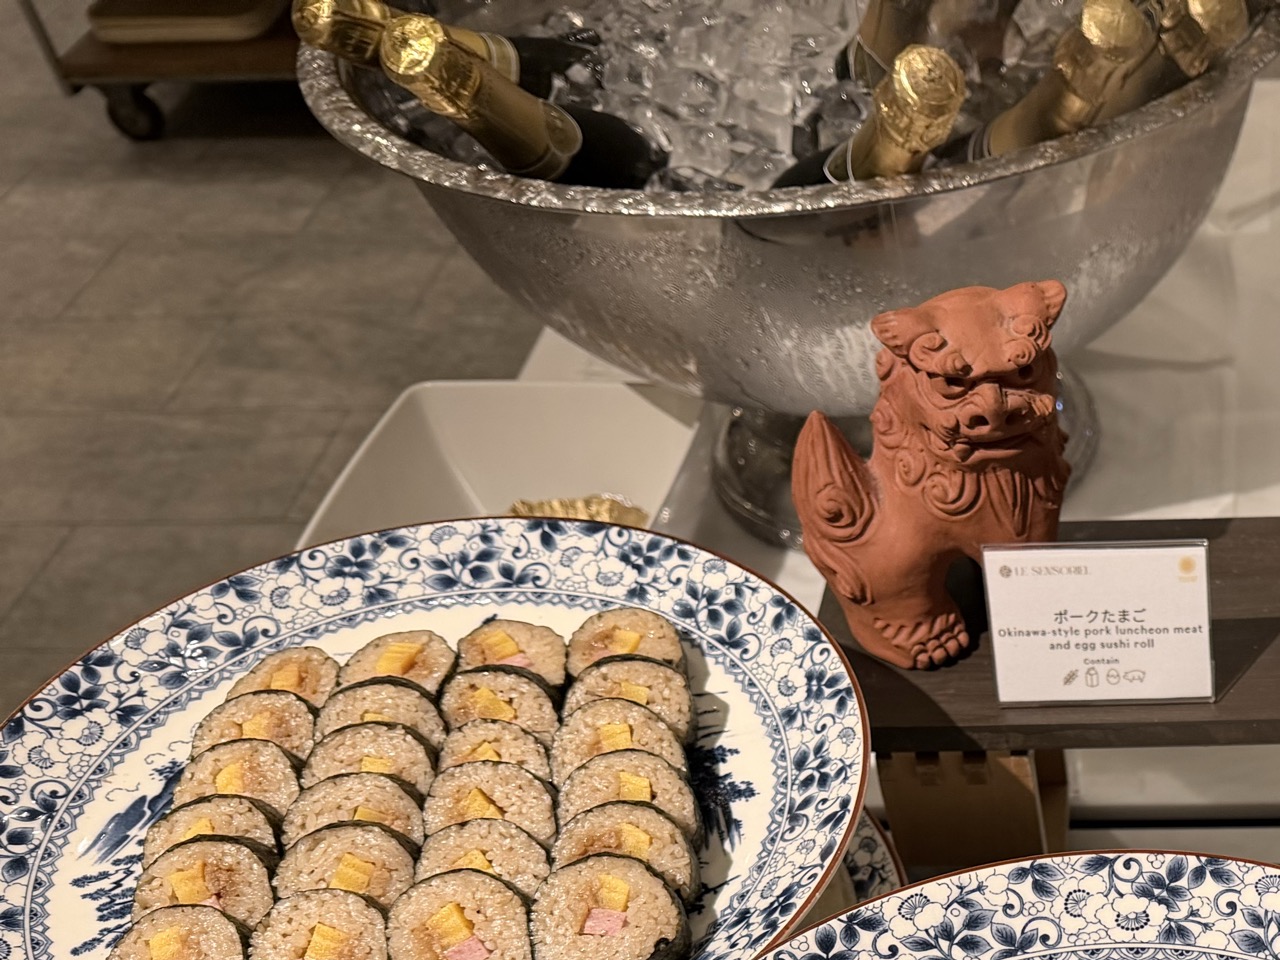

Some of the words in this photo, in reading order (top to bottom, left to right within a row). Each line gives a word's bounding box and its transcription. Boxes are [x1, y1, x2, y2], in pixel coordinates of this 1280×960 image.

[1014, 566, 1027, 576] LE
[1053, 608, 1147, 625] ポークたまご
[998, 625, 1081, 639] Okinawa-style
[1084, 624, 1112, 639] pork
[1115, 624, 1170, 636] luncheon
[1173, 624, 1204, 634] meat
[1049, 639, 1071, 651] and
[1074, 640, 1096, 652] egg
[1100, 637, 1131, 649] sushi
[1134, 637, 1155, 649] roll
[1083, 657, 1120, 666] Contain
